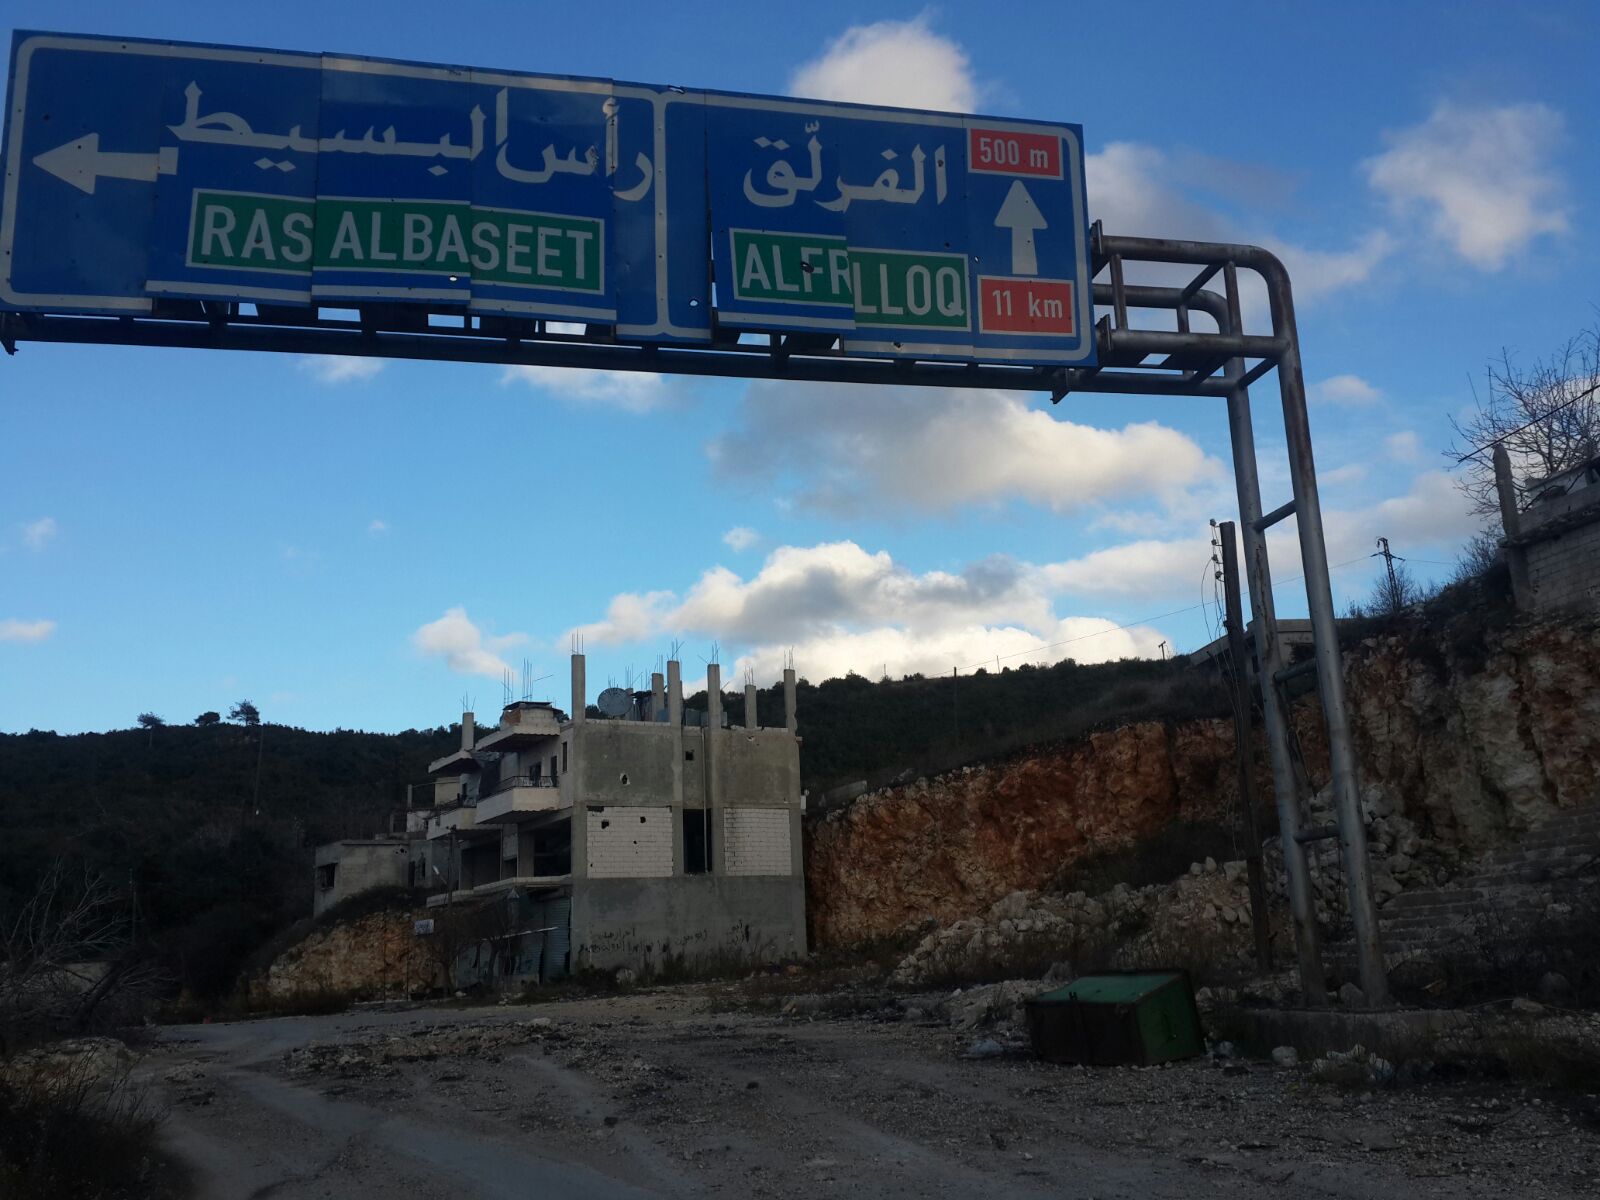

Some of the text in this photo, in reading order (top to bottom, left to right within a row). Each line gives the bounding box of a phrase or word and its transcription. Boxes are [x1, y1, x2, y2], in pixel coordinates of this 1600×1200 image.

[166, 80, 653, 201] رأس البسيط
[979, 137, 1048, 168] 500 m
[201, 205, 593, 280] RAS ALBASEET
[741, 243, 964, 317] ALFRLLOQ
[992, 290, 1063, 318] 11 km
